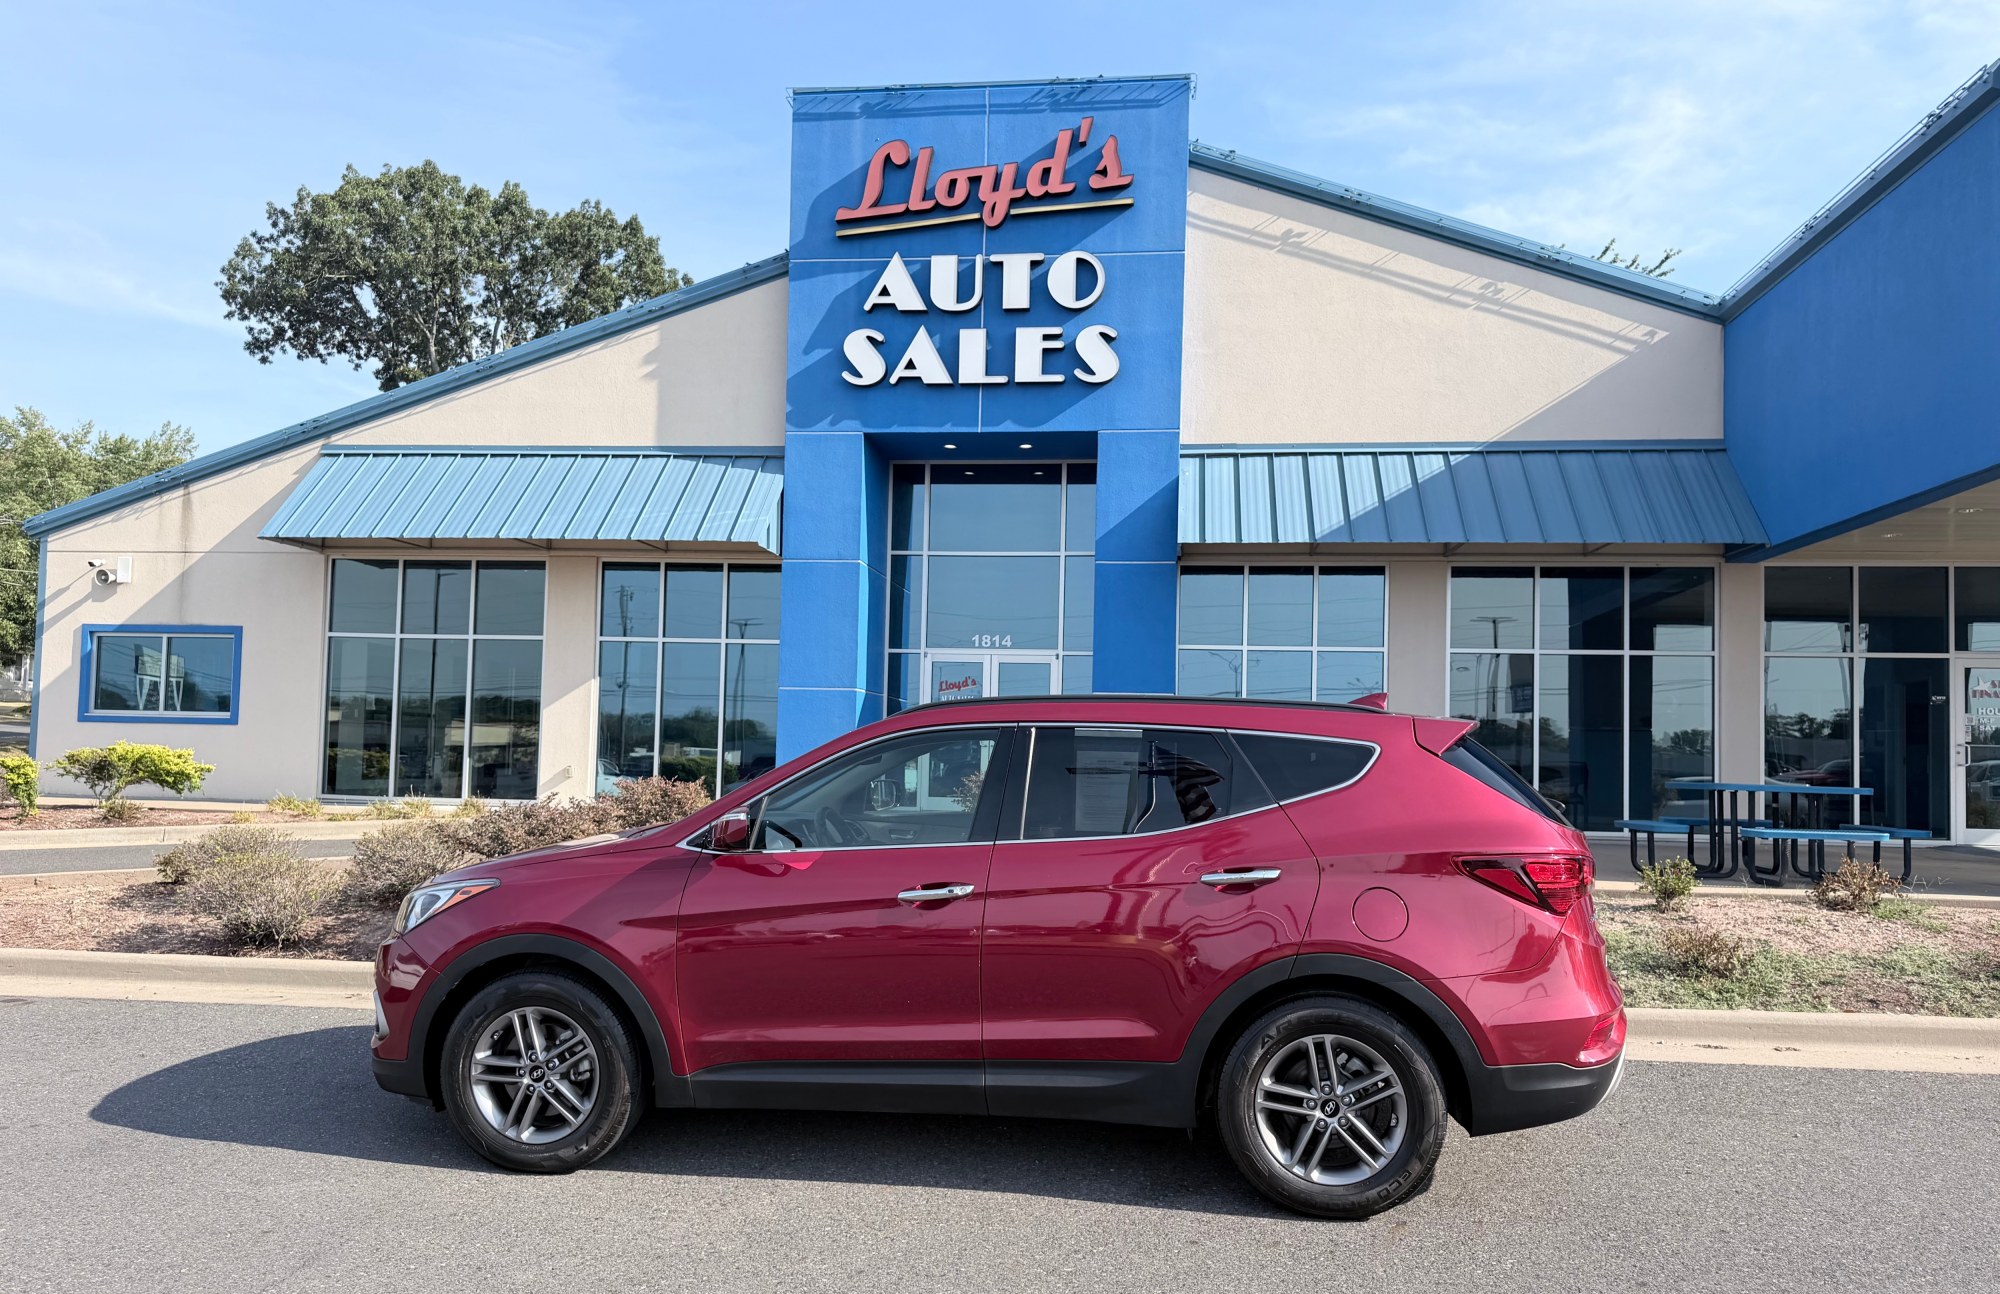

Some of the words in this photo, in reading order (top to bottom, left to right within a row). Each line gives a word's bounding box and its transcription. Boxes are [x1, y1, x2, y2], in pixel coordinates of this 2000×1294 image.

[835, 116, 1135, 228] Lloyd's
[863, 250, 1106, 313] AUTO
[841, 324, 1120, 386] SALES
[972, 634, 1012, 648] 1814
[939, 675, 977, 692] Lloyd's
